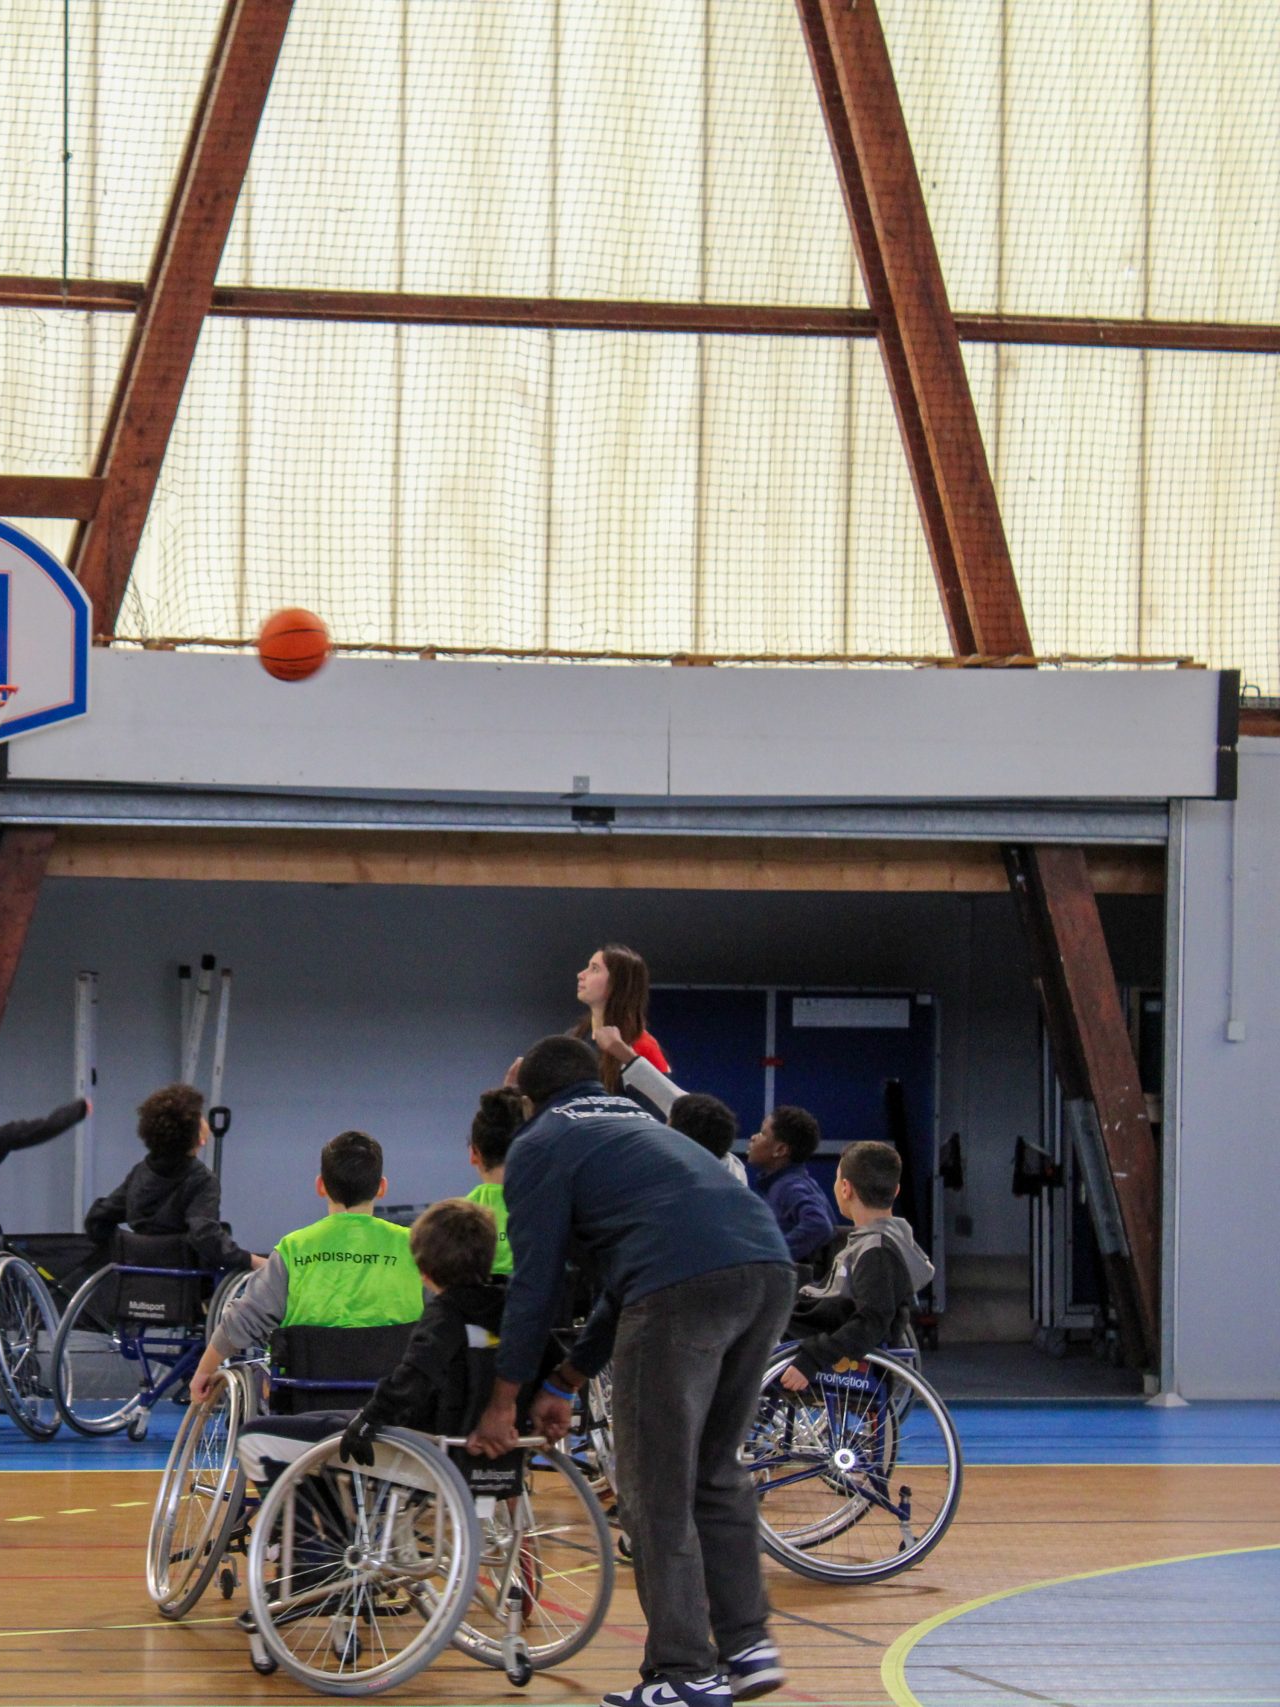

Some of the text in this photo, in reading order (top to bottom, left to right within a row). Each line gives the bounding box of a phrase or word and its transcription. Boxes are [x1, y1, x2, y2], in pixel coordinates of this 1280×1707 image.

[294, 1251, 398, 1267] HANDISPORT 77
[129, 1300, 166, 1311] Multisport
